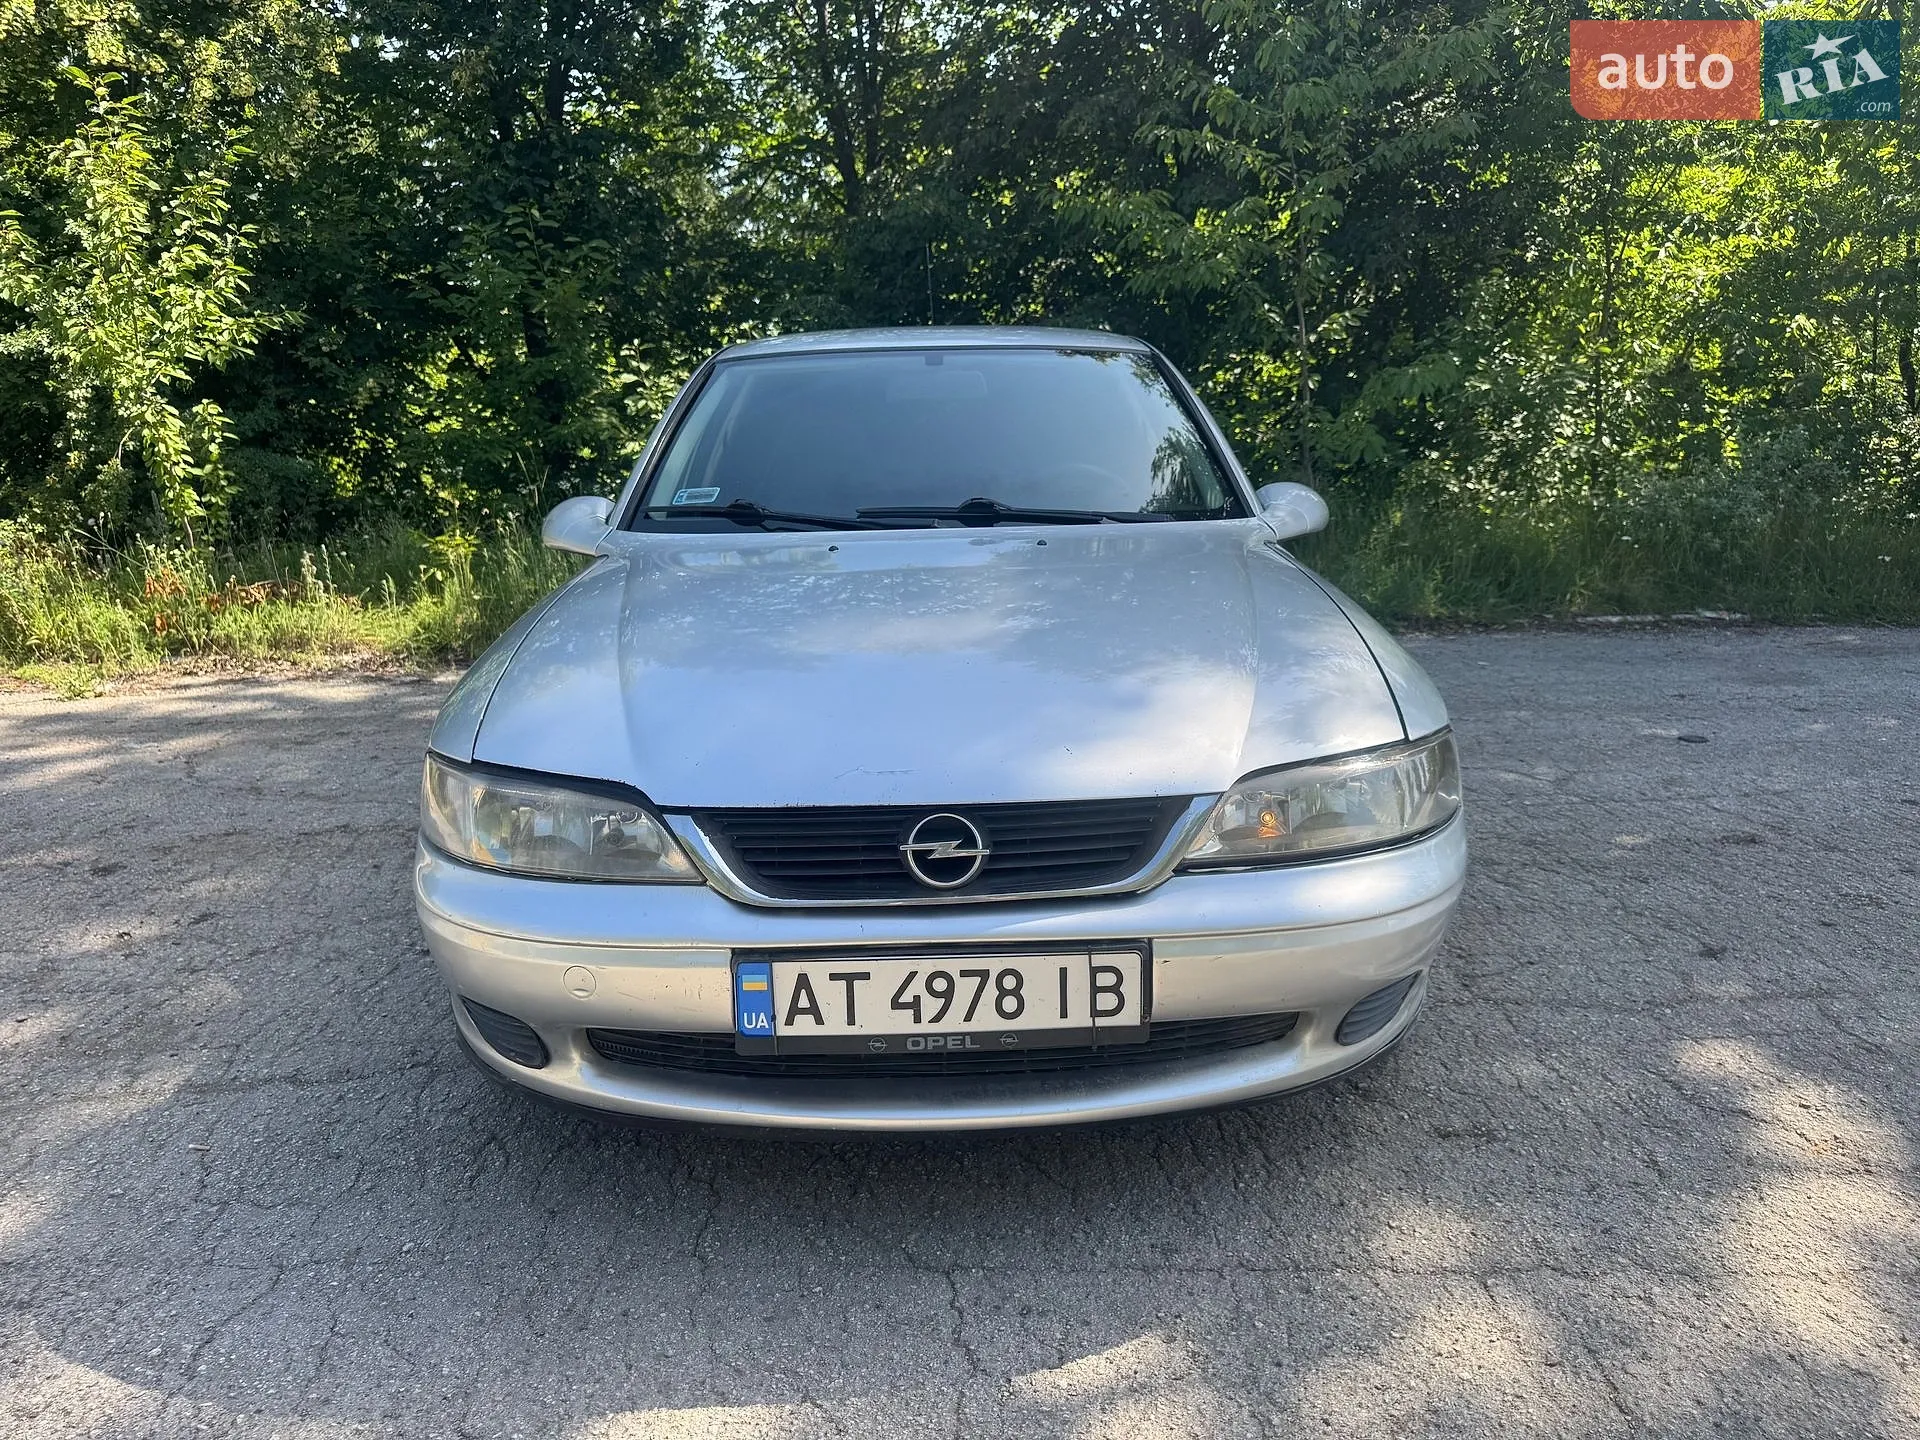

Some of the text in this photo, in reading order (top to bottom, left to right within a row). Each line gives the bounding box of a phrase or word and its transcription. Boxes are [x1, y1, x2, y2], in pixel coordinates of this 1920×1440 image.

[784, 964, 1125, 1026] AT 4978 IB
[743, 1012, 769, 1029] UA
[906, 1033, 981, 1051] OPEL
